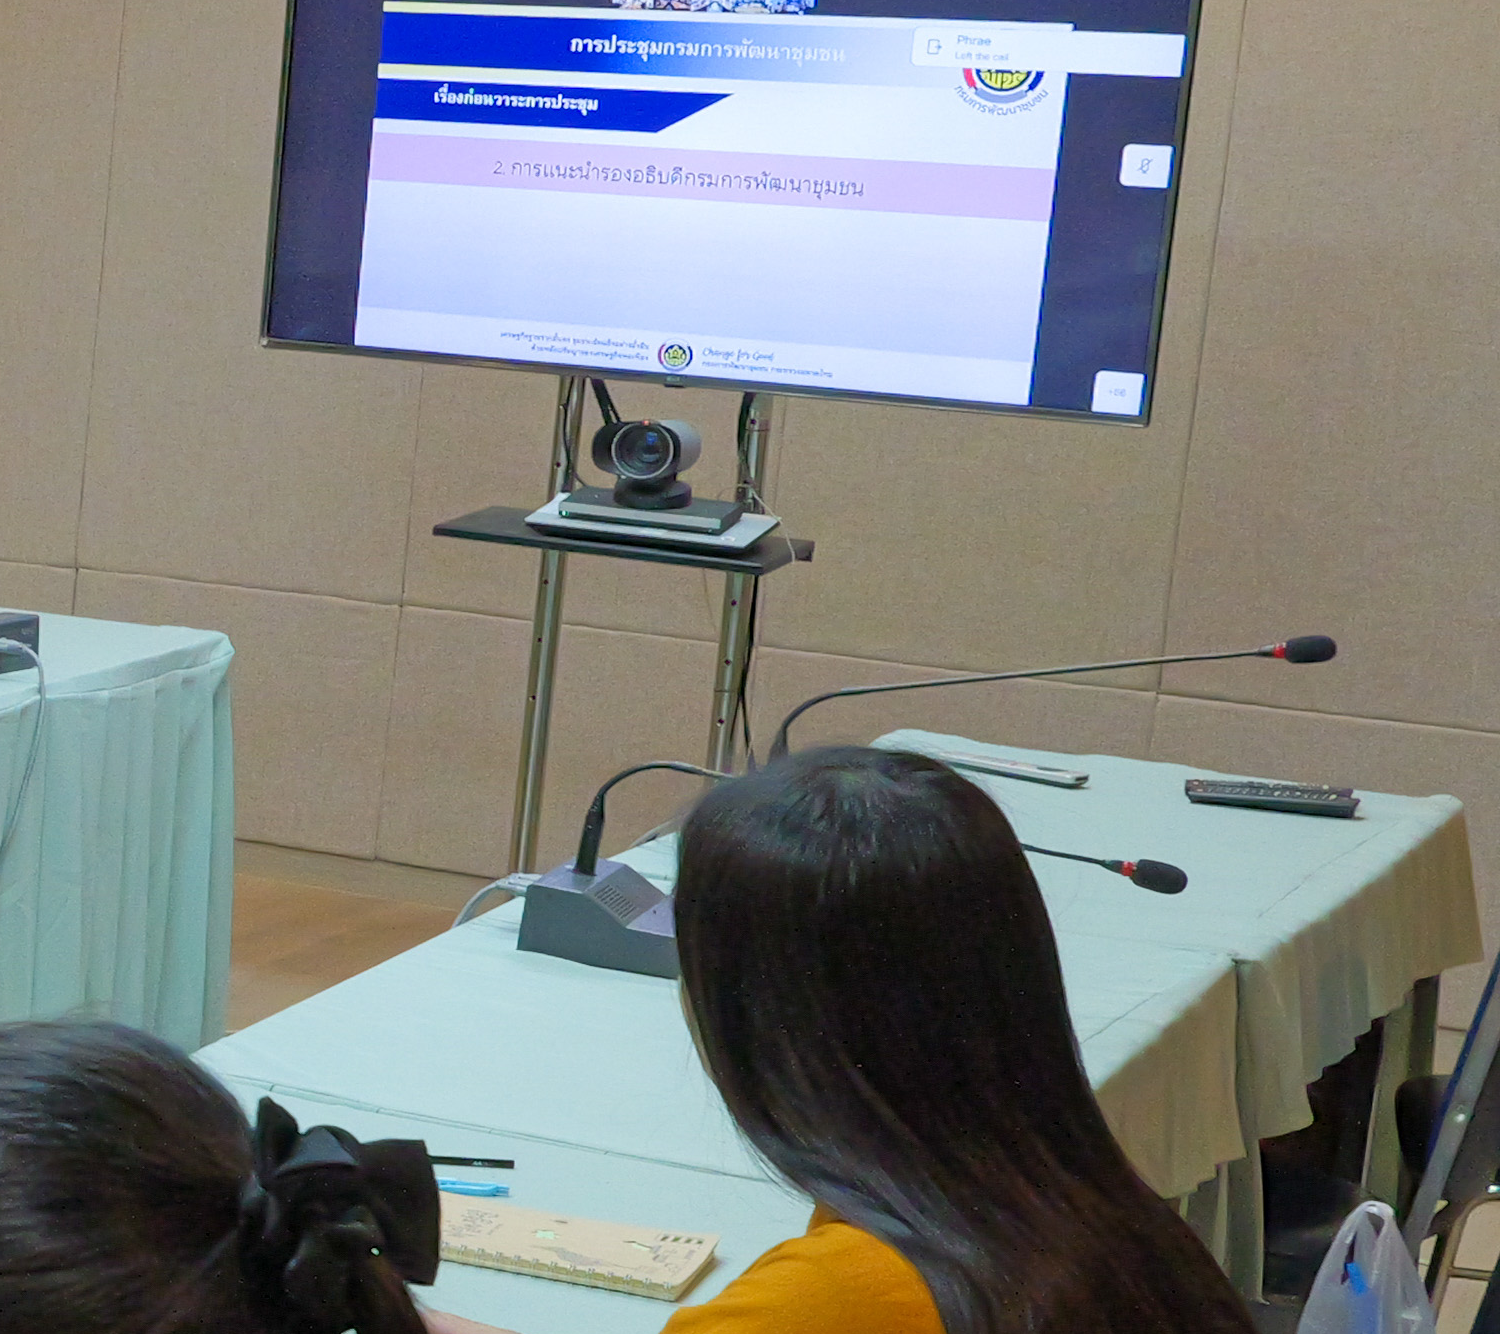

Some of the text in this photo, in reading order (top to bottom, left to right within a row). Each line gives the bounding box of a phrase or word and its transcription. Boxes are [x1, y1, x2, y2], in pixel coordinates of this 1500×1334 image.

[569, 34, 846, 66] การประชุมกรมการพัฒนาชุมชน
[957, 34, 992, 47] Phrae
[433, 83, 599, 116] เรื่องก่อนวาระการประชุม
[511, 160, 865, 200] การแนะนำรองอธิบดีกรมการพัฒนาชุมชน
